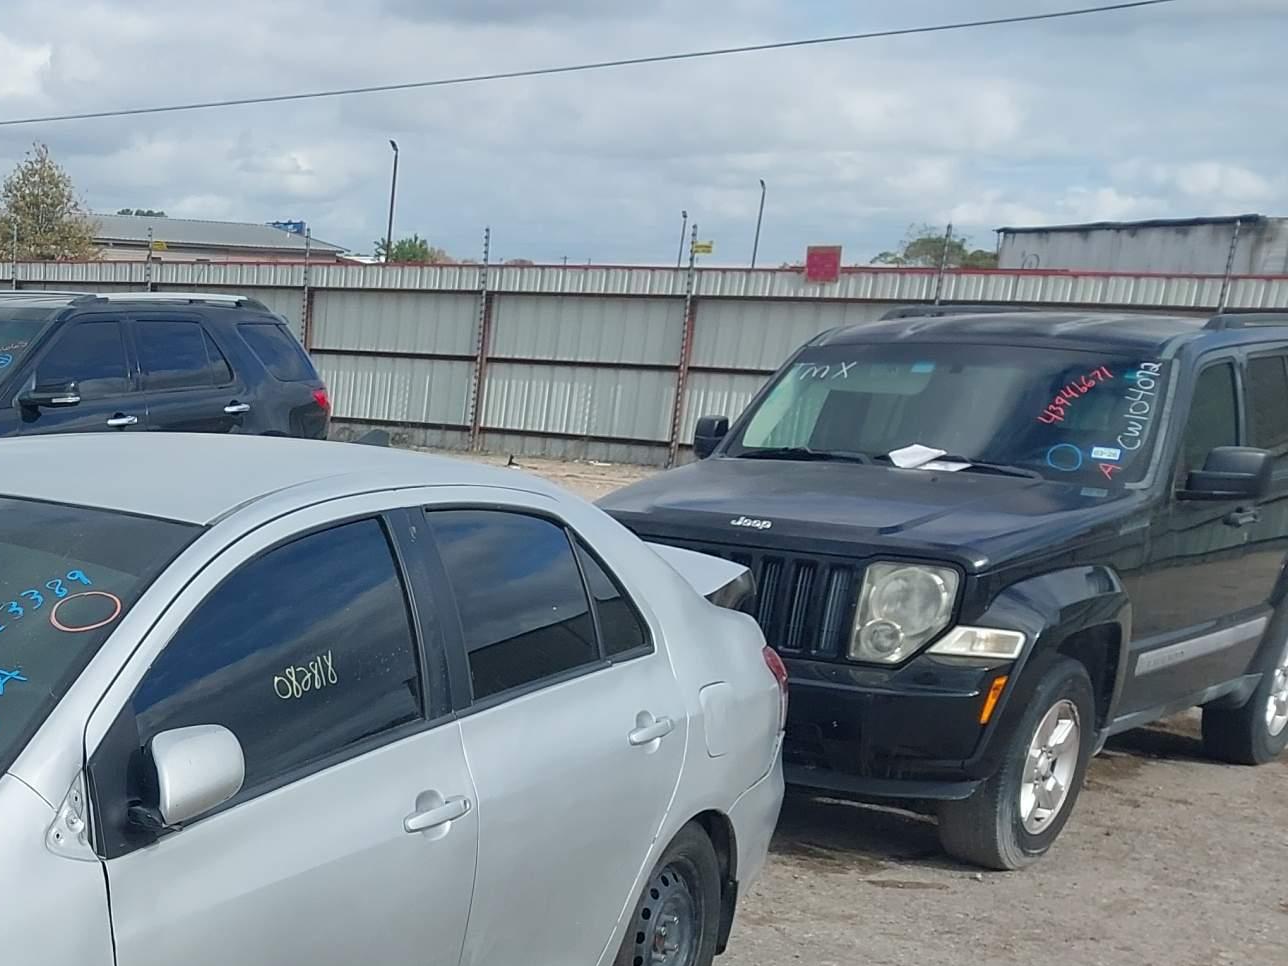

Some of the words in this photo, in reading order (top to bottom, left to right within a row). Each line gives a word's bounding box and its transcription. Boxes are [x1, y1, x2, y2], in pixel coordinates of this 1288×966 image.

[1037, 366, 1114, 424] 43946671
[1116, 362, 1164, 451] CW104072
[1098, 462, 1123, 480] A
[730, 516, 772, 530] Jeep
